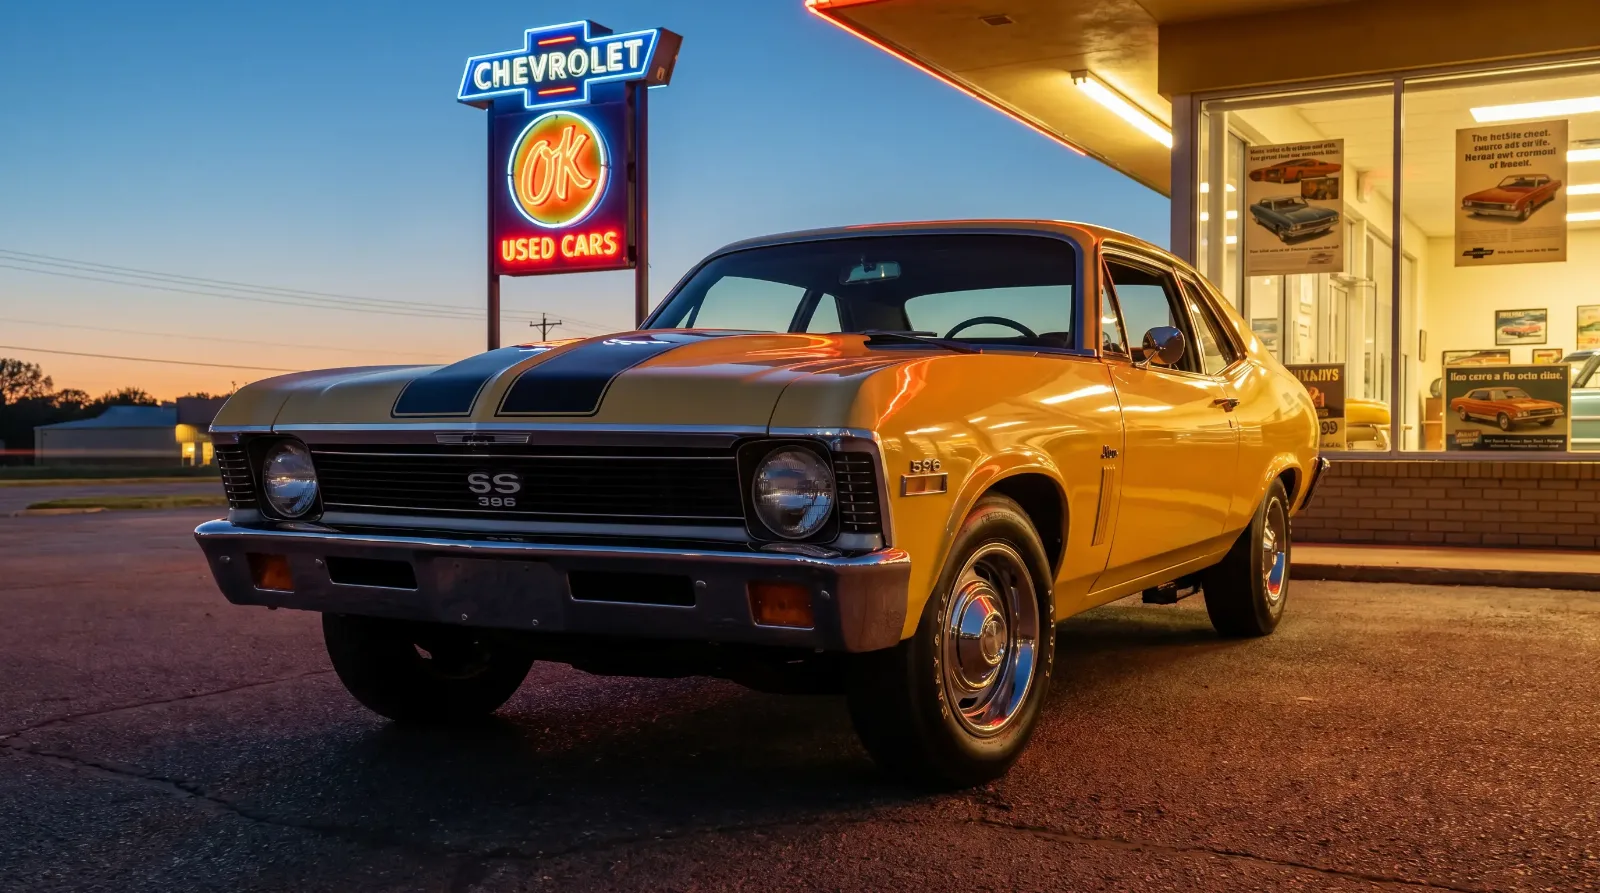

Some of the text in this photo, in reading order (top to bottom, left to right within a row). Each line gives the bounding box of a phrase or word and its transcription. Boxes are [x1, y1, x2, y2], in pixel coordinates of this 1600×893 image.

[474, 39, 644, 90] CHEVROLET
[1472, 134, 1488, 142] The
[521, 125, 595, 206] OK
[502, 231, 617, 261] USED CARS
[467, 473, 521, 494] SS
[478, 497, 516, 508] 396
